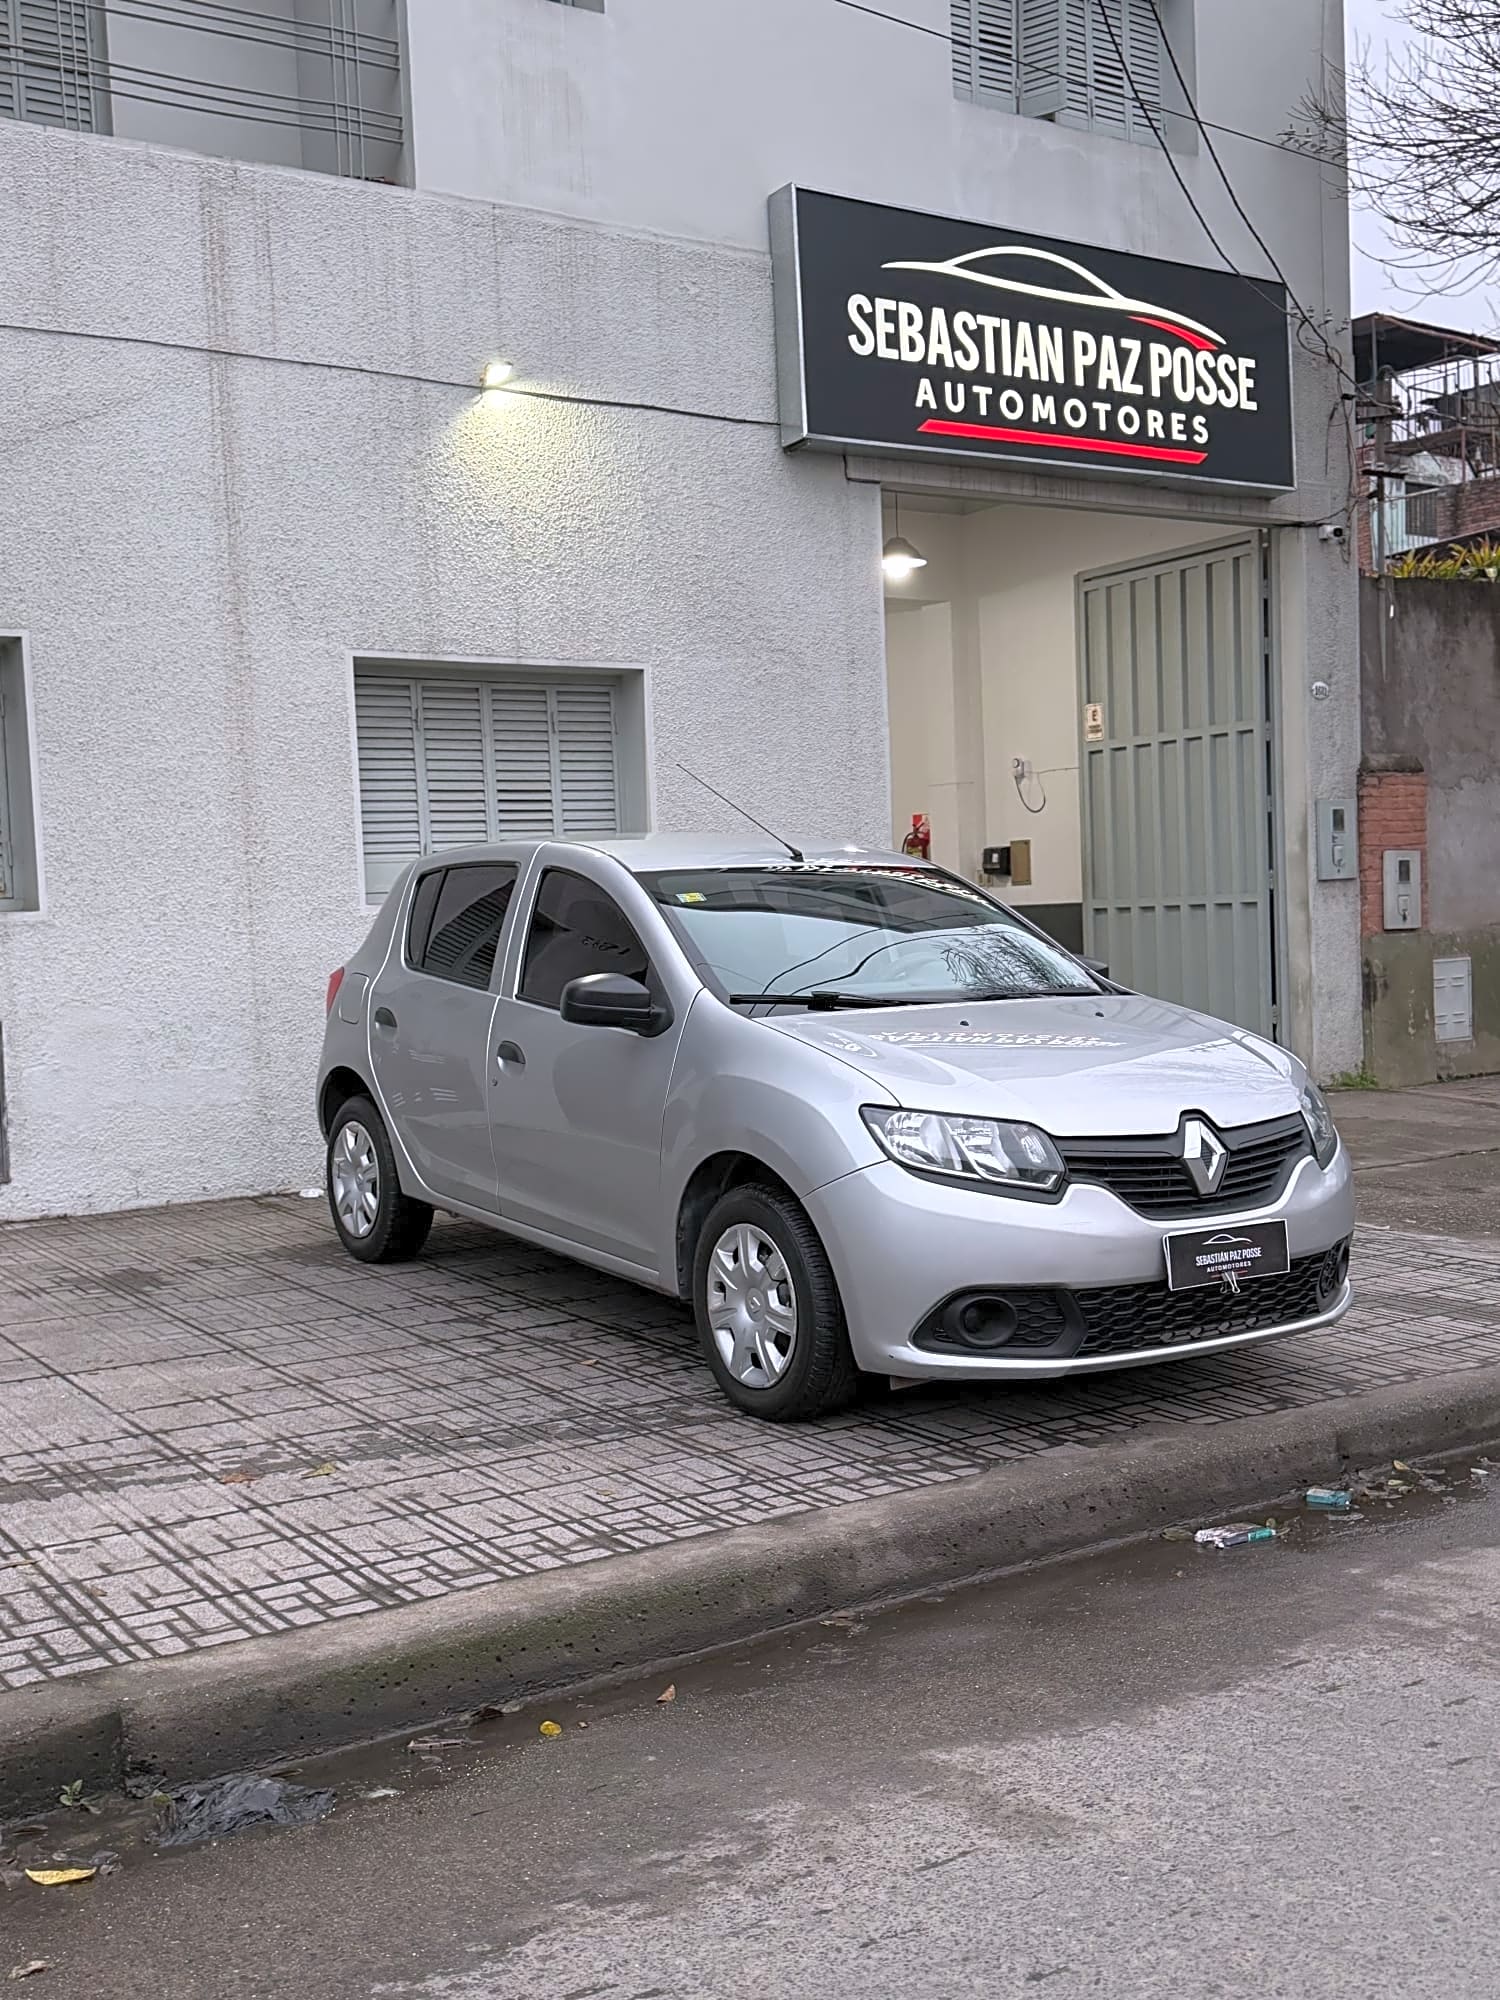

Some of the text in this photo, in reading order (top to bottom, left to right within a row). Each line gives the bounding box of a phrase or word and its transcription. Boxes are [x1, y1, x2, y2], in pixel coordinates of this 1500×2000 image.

[847, 293, 1259, 411] SEBASTIAN PAZ POSSE
[915, 378, 1209, 444] AUTOMOTORES
[1206, 1260, 1252, 1273] AUTOMOTORES
[1230, 1250, 1242, 1261] PAZ
[1242, 1247, 1262, 1259] POSSE
